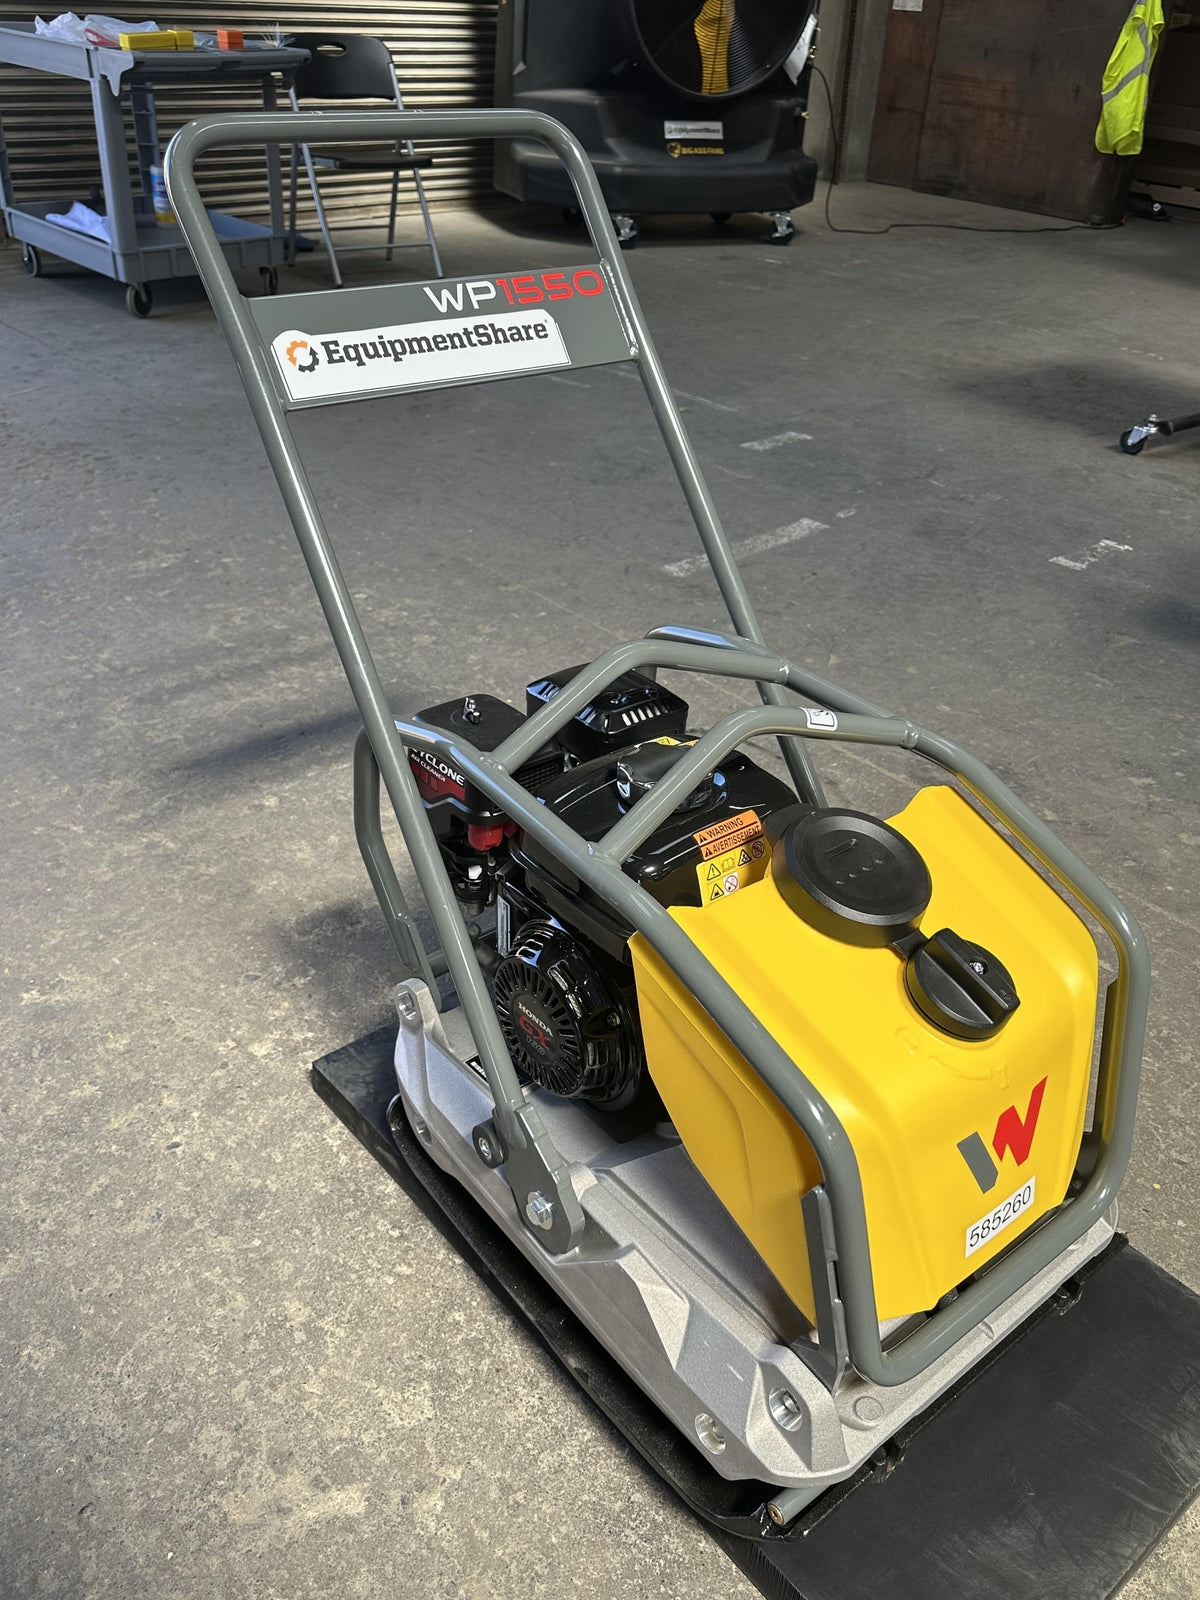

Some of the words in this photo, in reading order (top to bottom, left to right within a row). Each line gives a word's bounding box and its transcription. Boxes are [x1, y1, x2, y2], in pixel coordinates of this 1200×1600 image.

[423, 270, 604, 314] WP1550
[320, 321, 549, 367] EquipmentShare
[420, 760, 446, 783] CLEANER
[706, 817, 744, 839] WARNING
[713, 825, 760, 853] AVERTISSEMENT
[518, 1001, 554, 1037] HONDA
[519, 1016, 551, 1050] GX
[969, 1185, 1032, 1248] 585260
